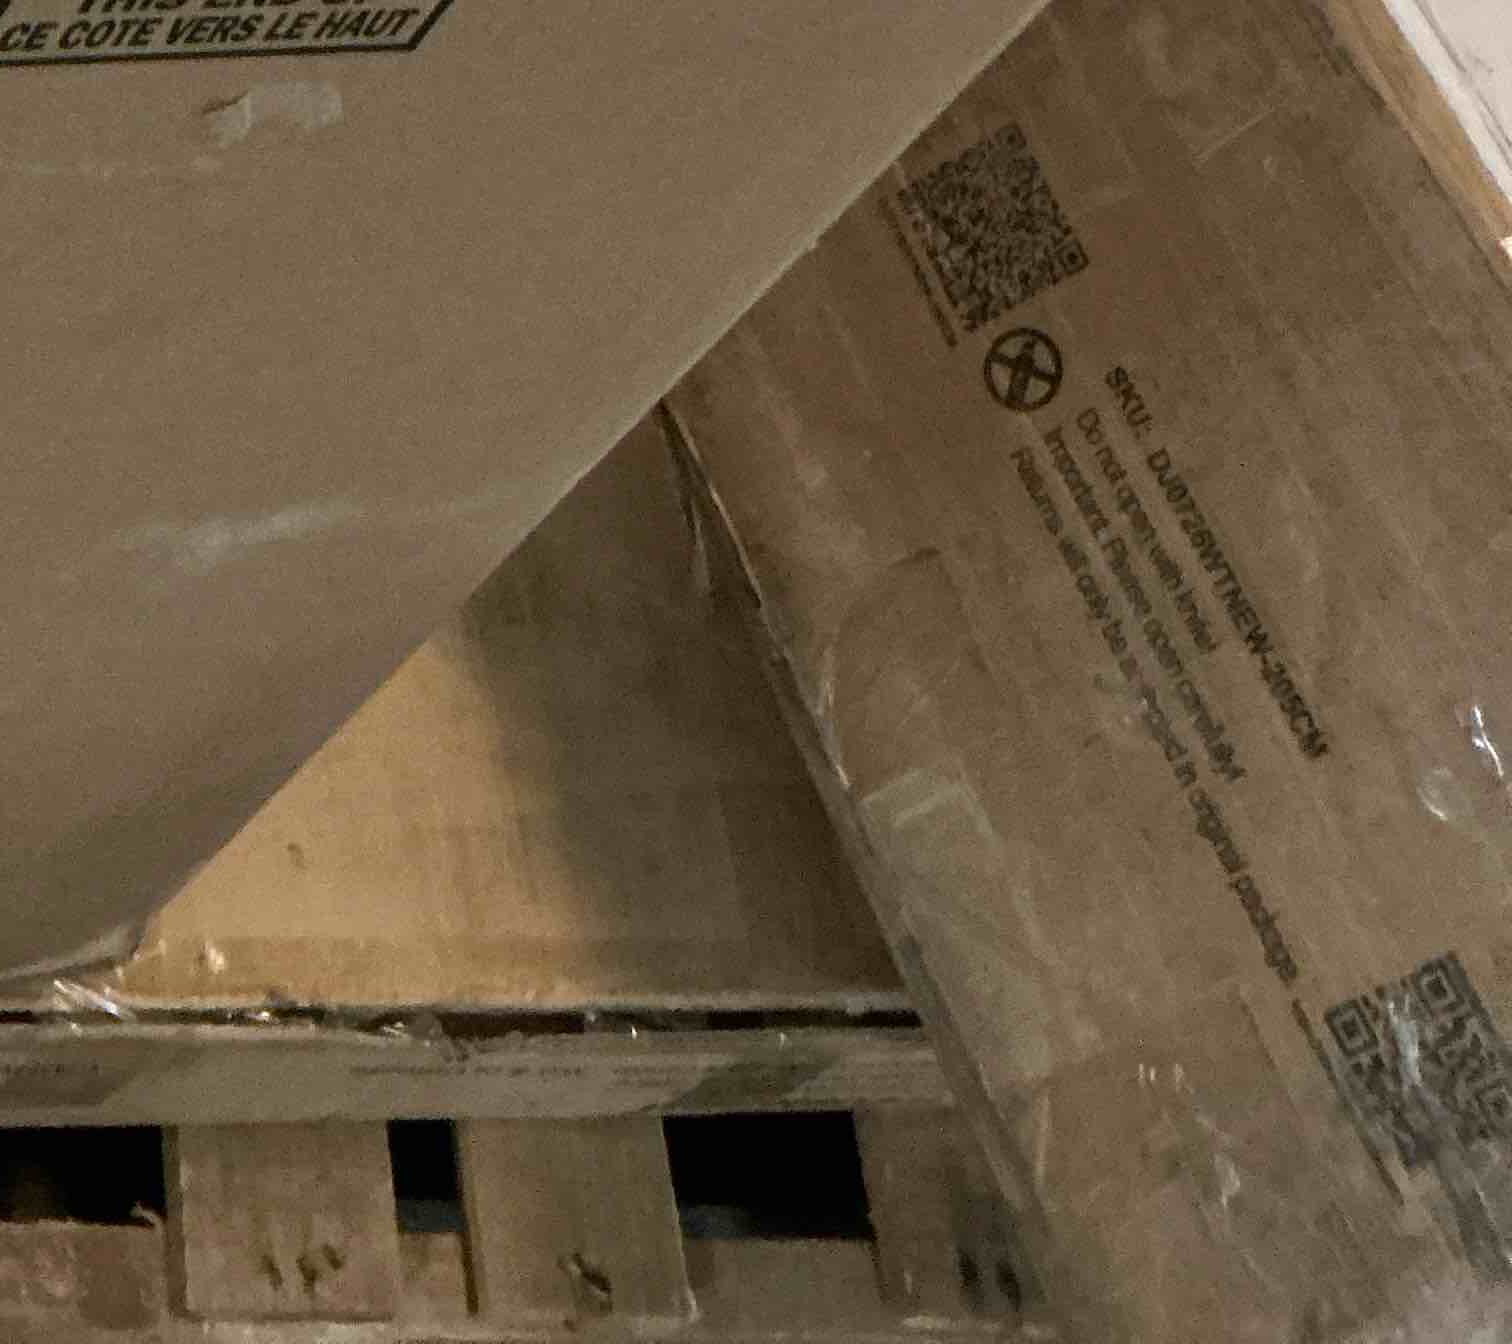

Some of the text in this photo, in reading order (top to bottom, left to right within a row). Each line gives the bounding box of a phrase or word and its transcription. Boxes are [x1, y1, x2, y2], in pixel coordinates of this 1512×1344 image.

[58, 15, 163, 51] COTE
[164, 12, 265, 47] VERS
[263, 10, 323, 42] LE
[317, 5, 422, 40] HAUT
[1101, 363, 1159, 441] SKU:
[1072, 406, 1110, 449] Do
